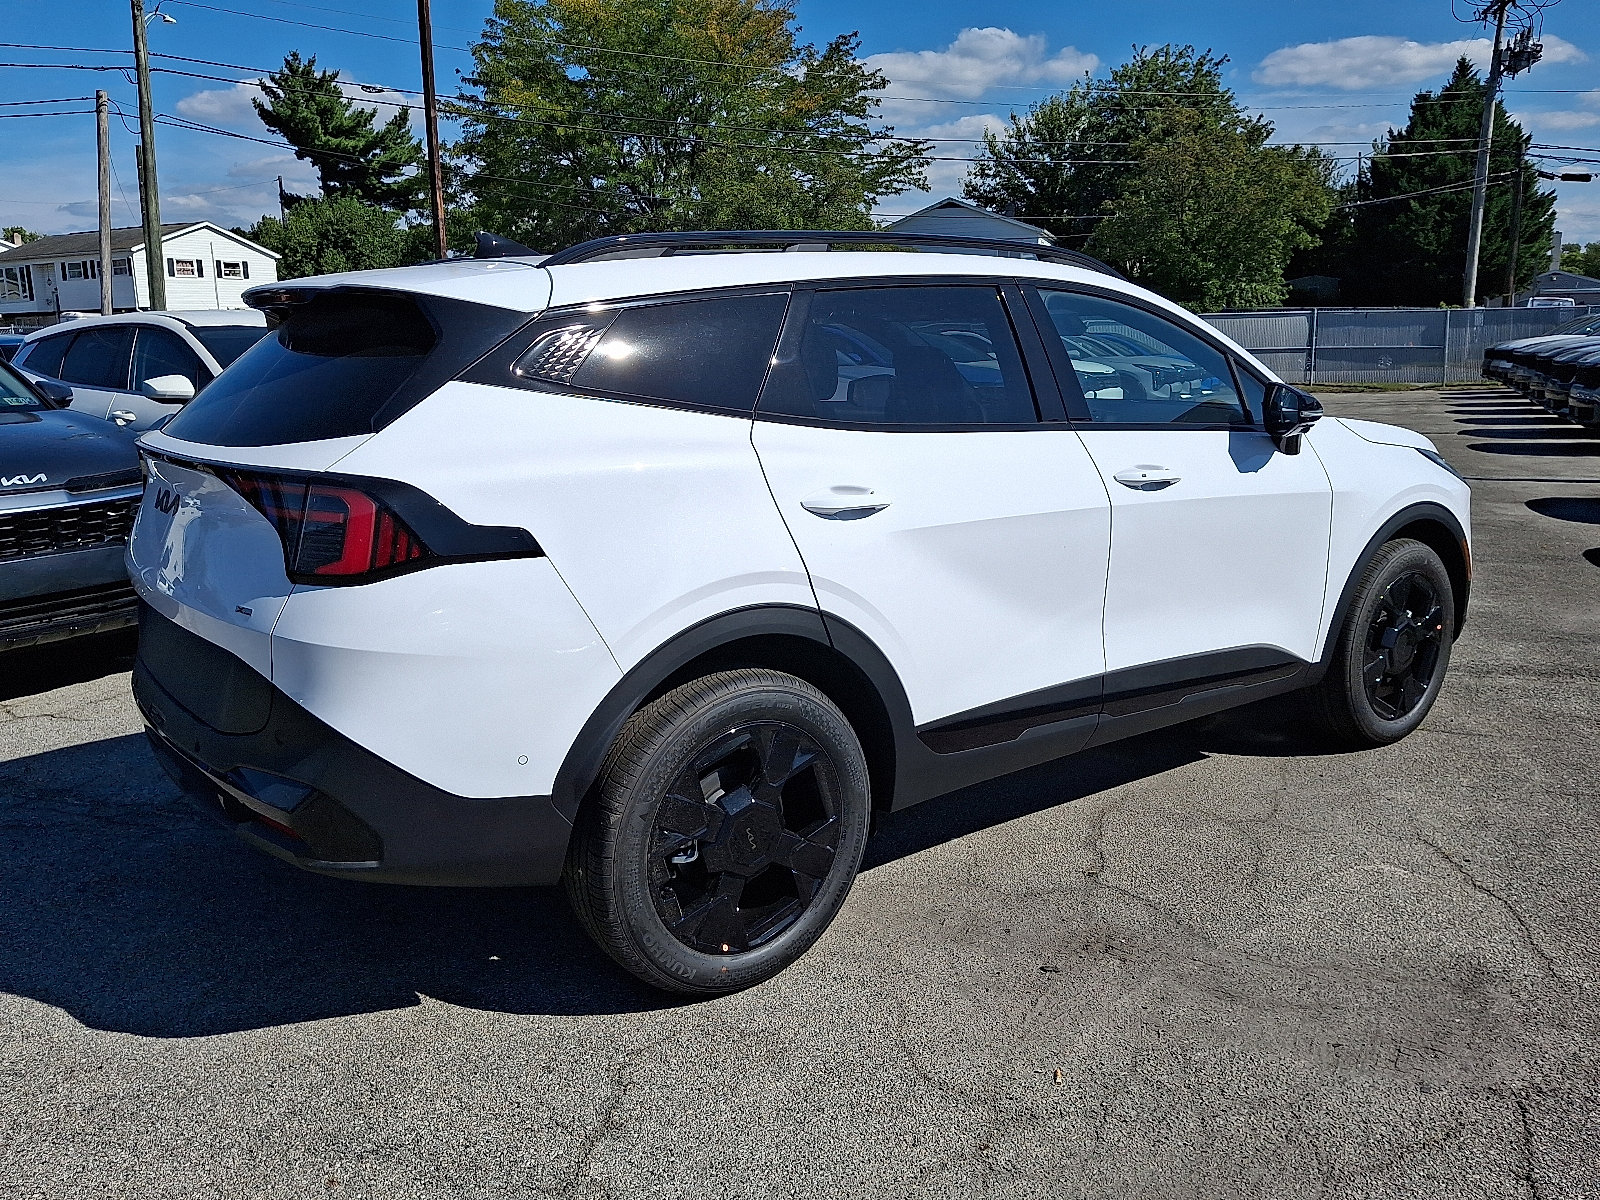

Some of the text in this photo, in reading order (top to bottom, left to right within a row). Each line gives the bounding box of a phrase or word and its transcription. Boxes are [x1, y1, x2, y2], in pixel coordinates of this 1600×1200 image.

[1, 473, 47, 487] KIA
[154, 487, 181, 517] KIA
[642, 931, 698, 981] KUMHO
